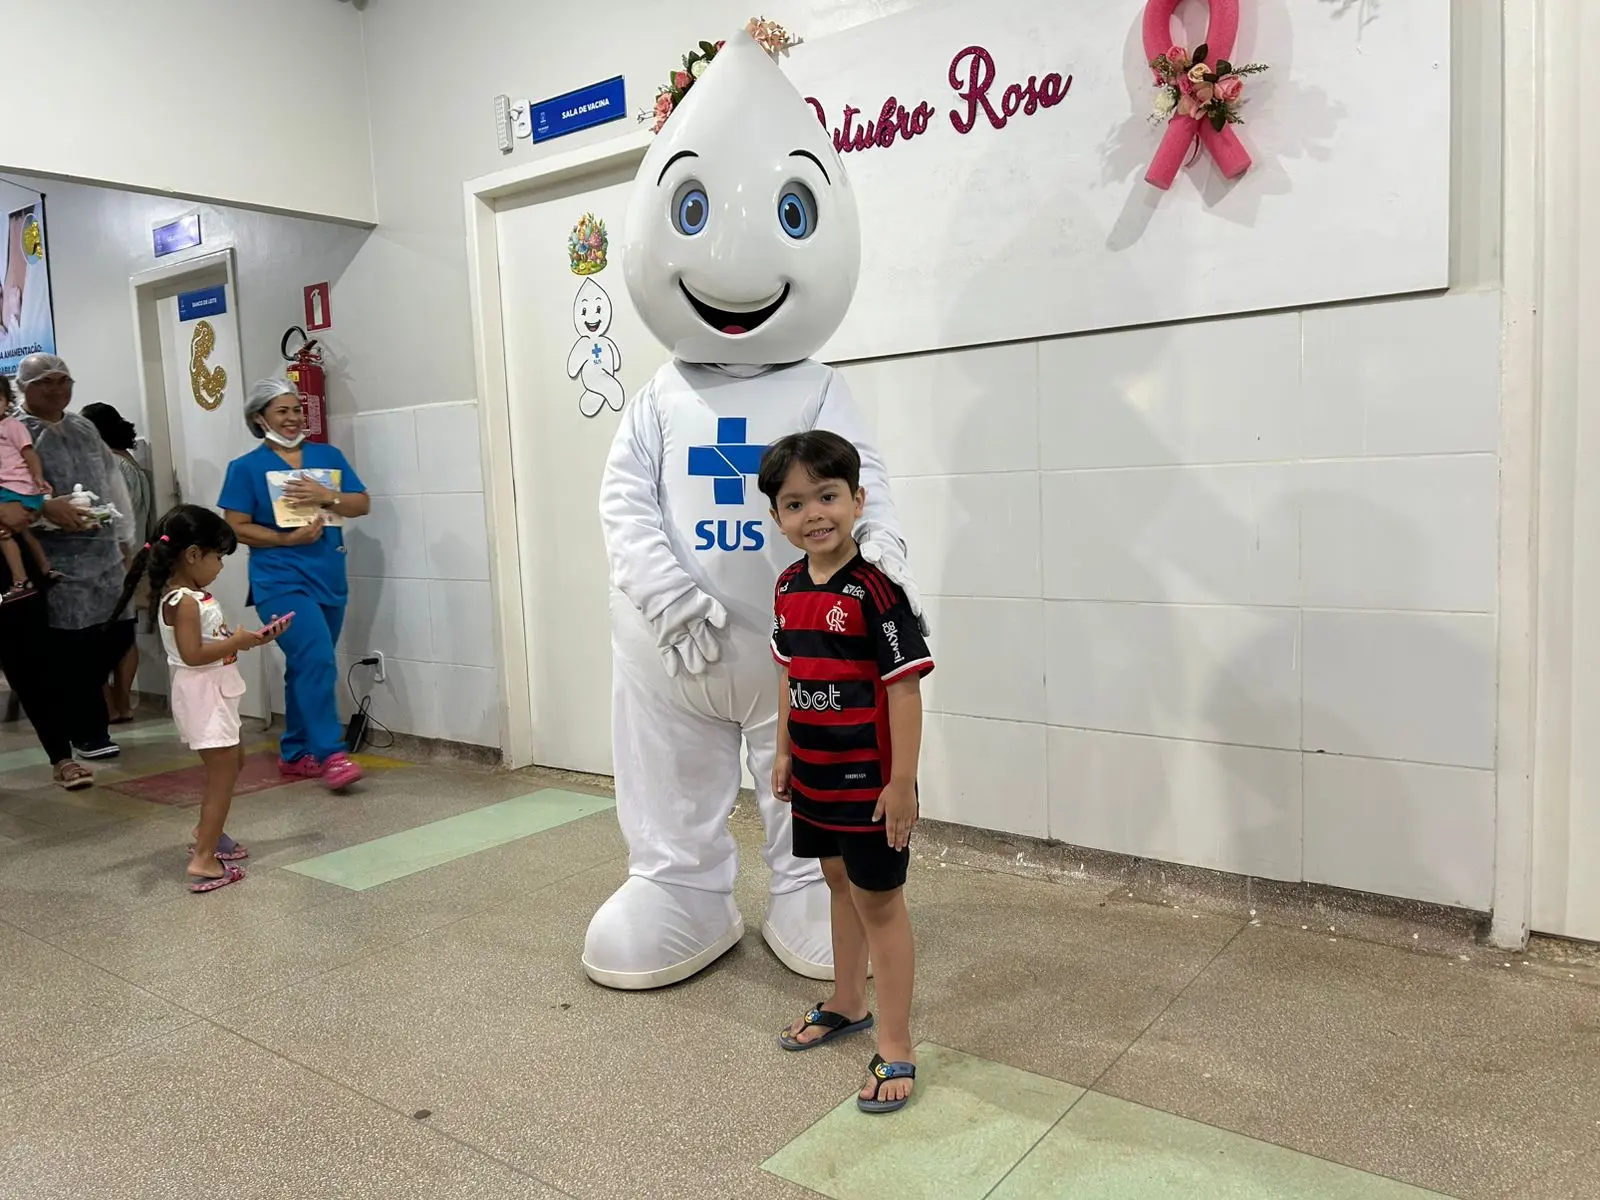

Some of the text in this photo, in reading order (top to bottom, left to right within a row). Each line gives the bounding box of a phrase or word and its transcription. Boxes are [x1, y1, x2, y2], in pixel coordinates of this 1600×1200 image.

[948, 45, 1073, 134] Rosa
[561, 98, 610, 119] SALA DE VACINA
[694, 519, 765, 551] SUS
[886, 629, 905, 664] Kwai
